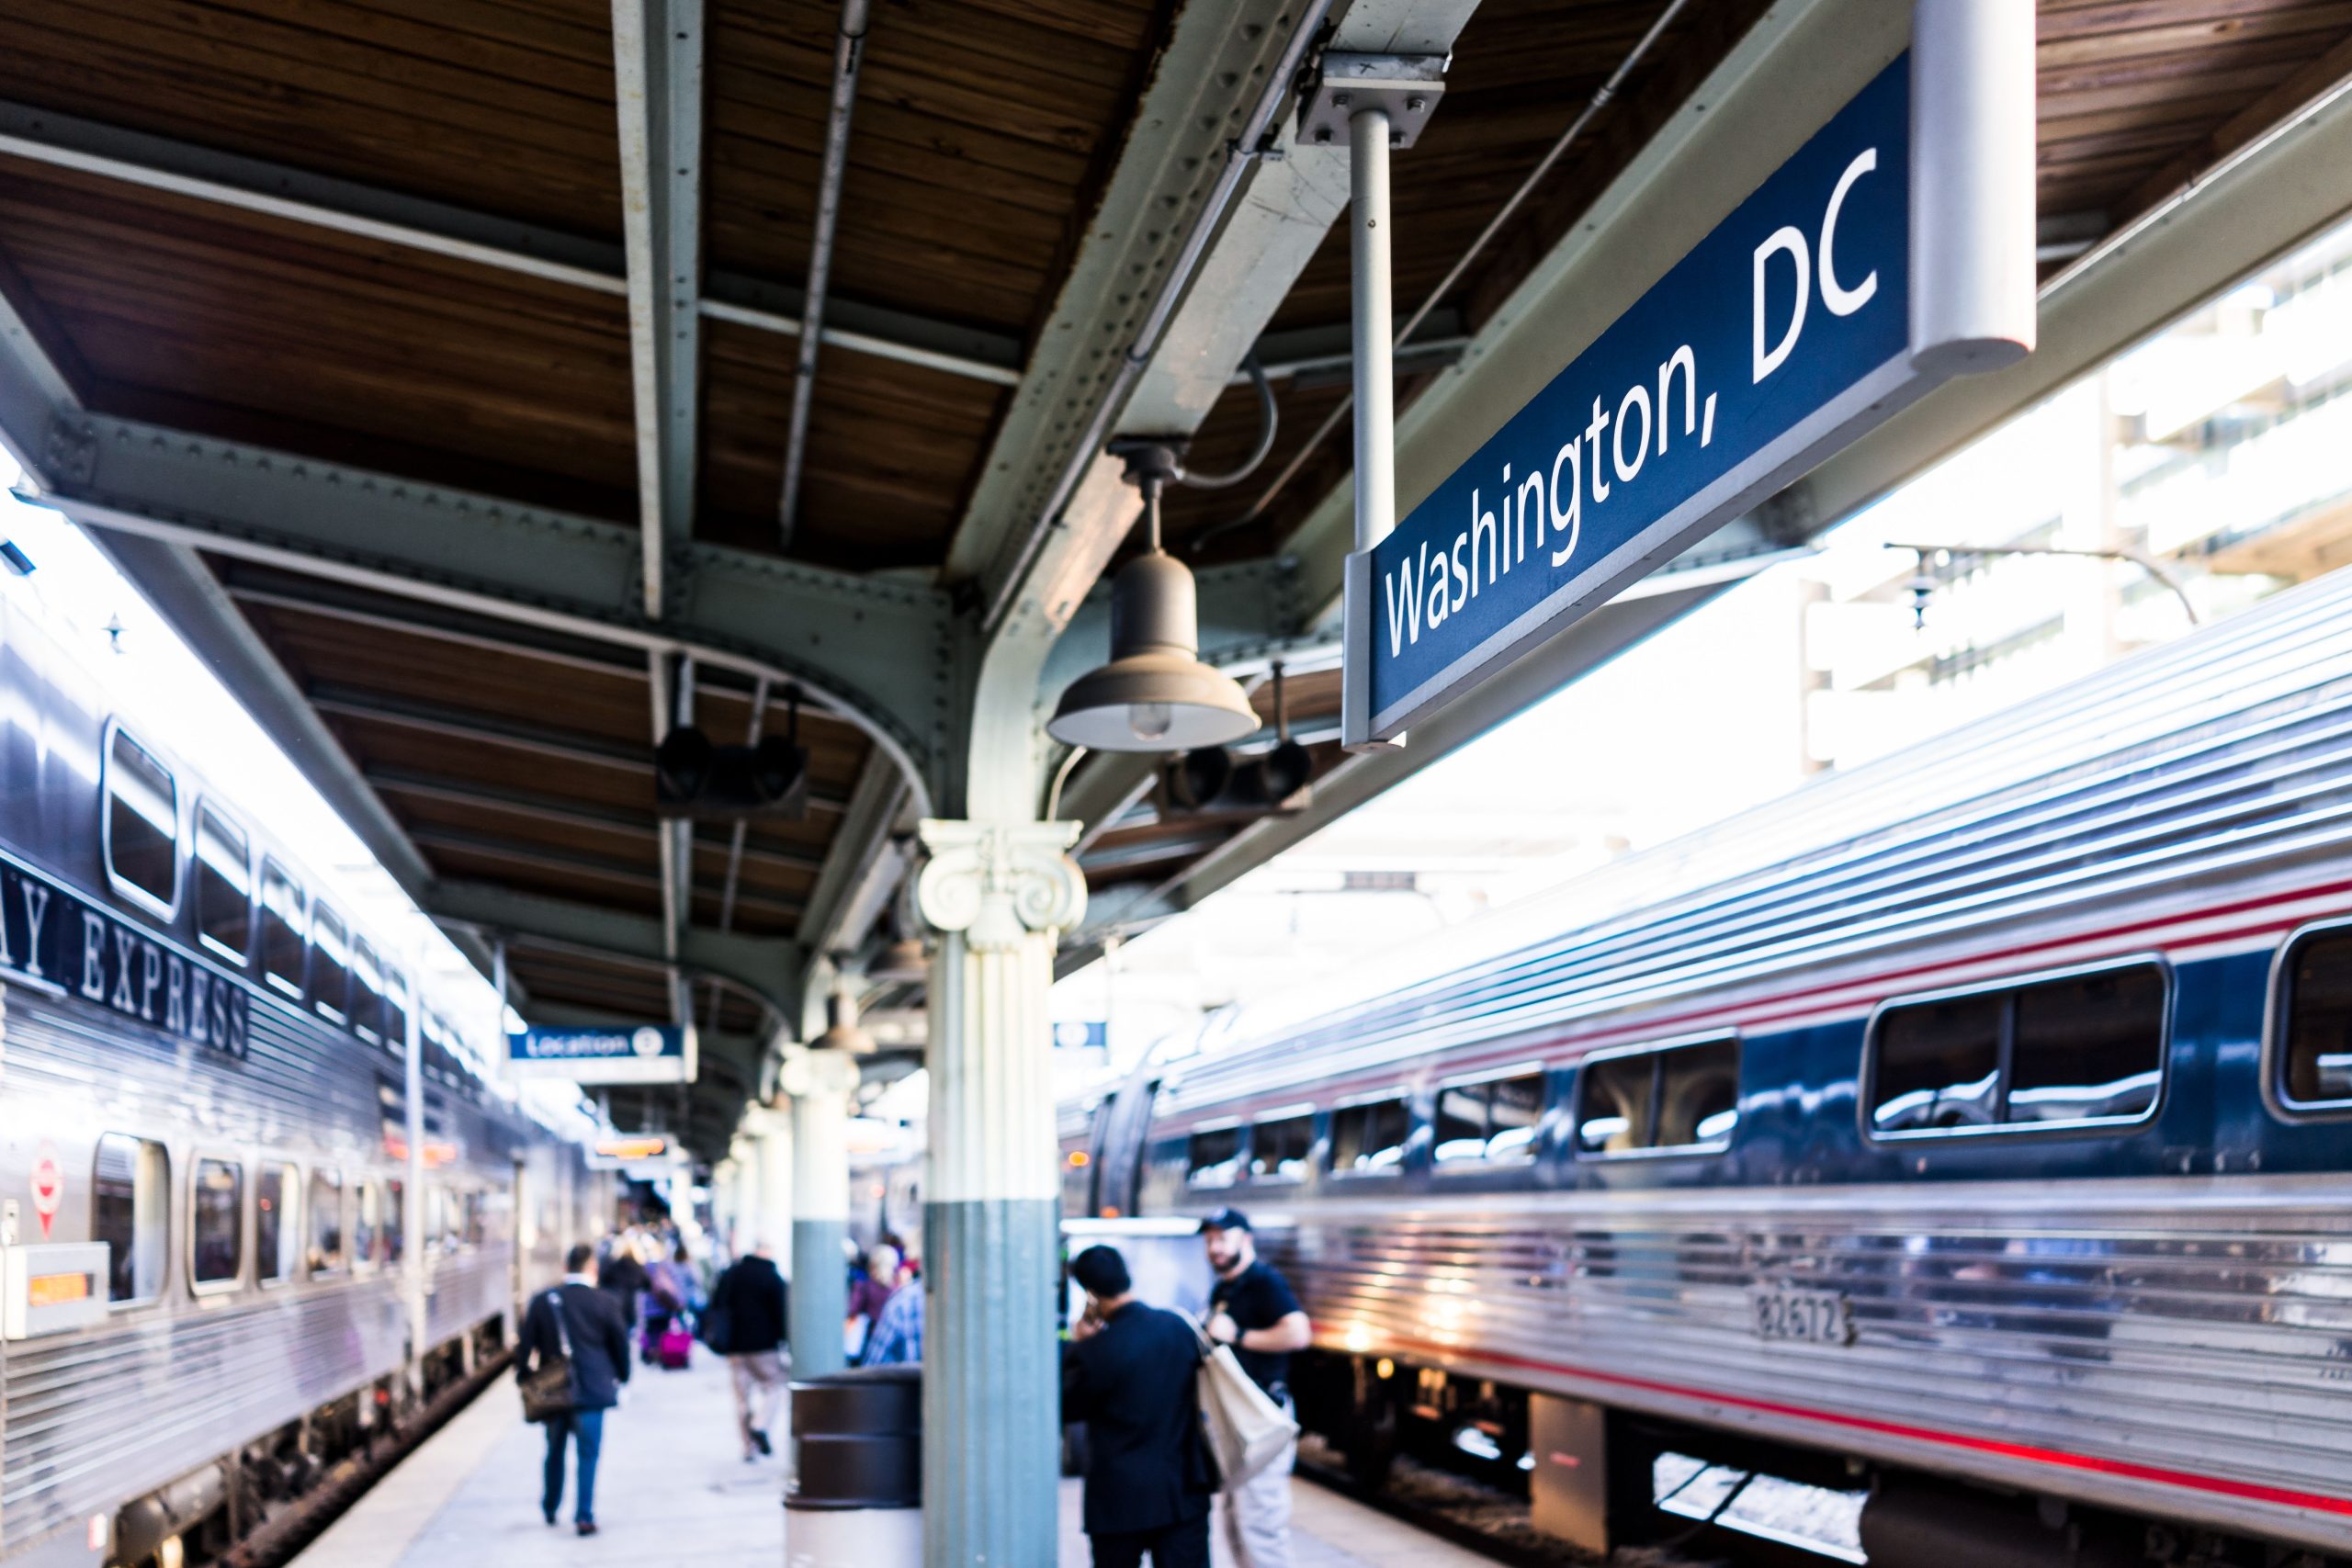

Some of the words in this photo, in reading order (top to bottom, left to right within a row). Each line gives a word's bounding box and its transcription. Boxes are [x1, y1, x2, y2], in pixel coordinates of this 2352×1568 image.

[1385, 344, 1717, 659] Washington,
[1753, 147, 1878, 384] DC
[82, 910, 245, 1057] EXPRESS
[526, 1032, 629, 1057] Location
